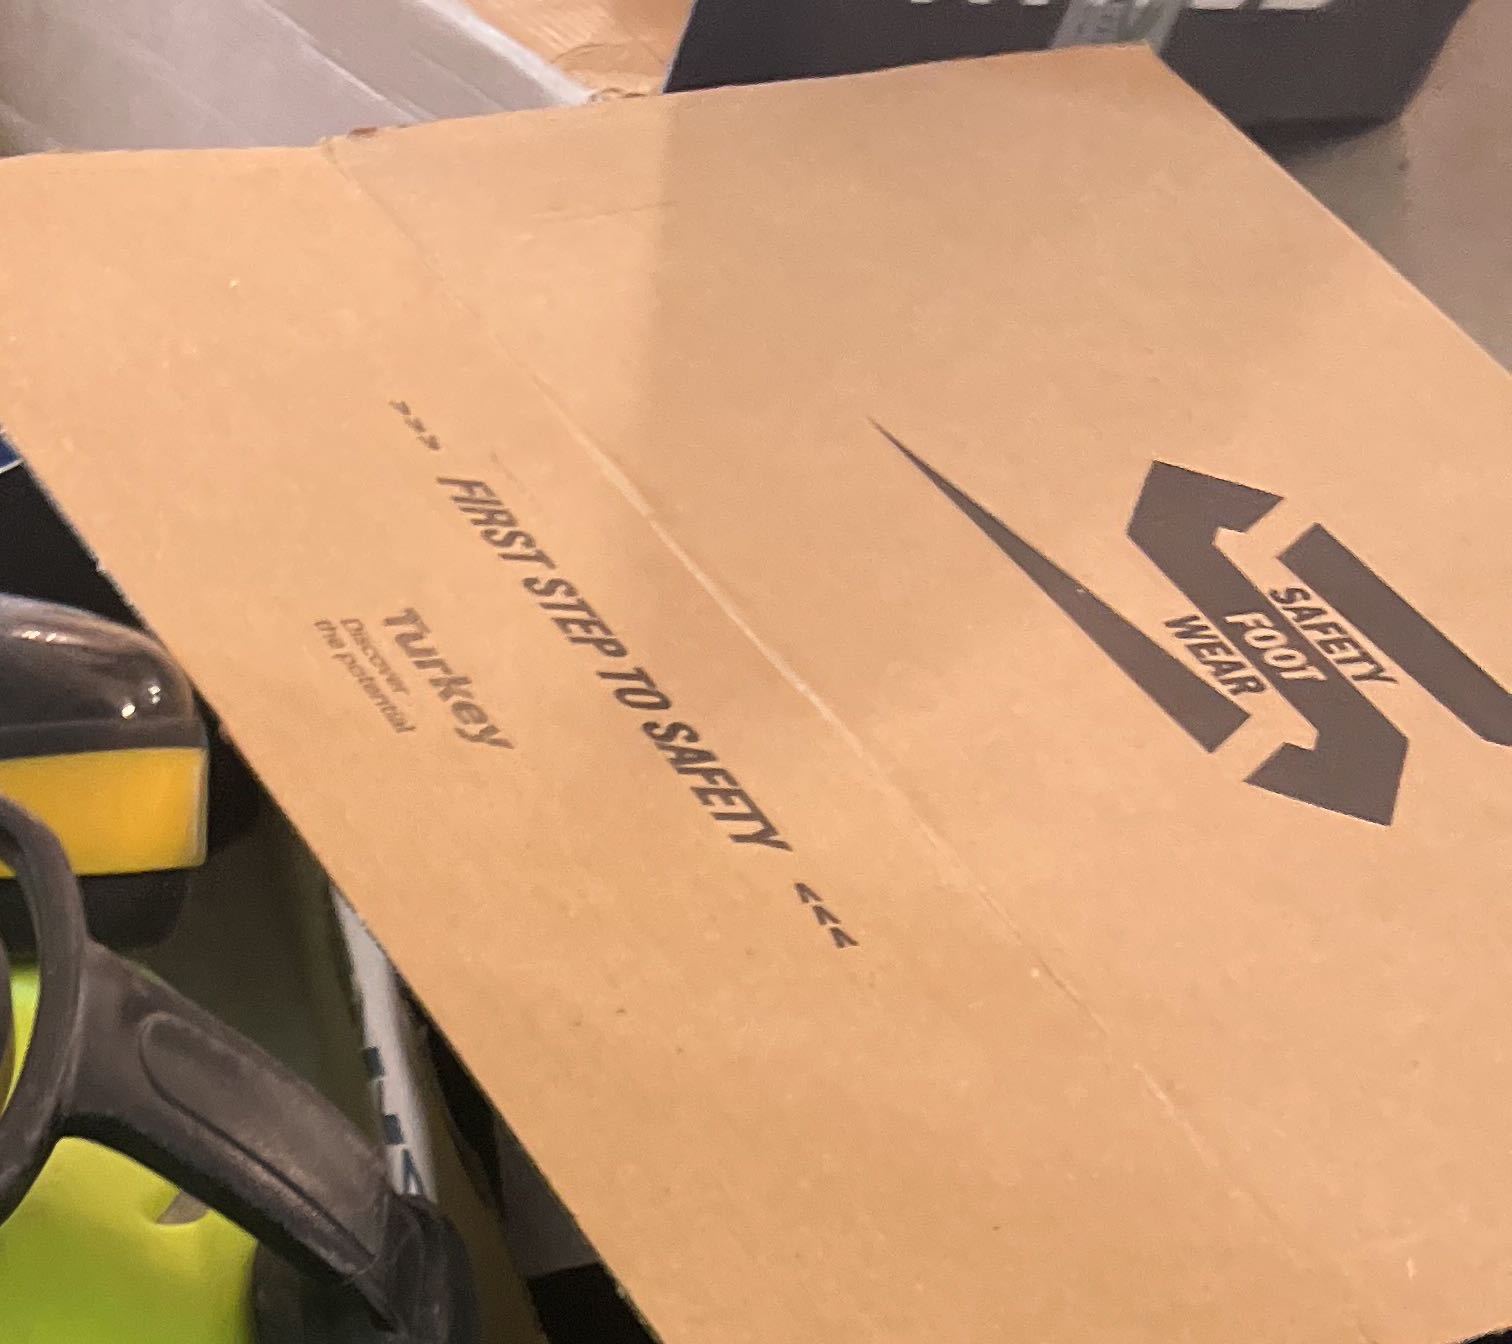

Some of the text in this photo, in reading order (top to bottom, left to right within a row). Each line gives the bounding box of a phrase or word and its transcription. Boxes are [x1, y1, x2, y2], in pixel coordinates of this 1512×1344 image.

[314, 618, 416, 734] the potential
[340, 618, 410, 695] Discover
[382, 607, 515, 750] Turkey
[436, 476, 792, 852] FIRST STEP TO SAFETY
[1162, 614, 1268, 697] WEAR
[1223, 611, 1328, 683] FOOT
[1269, 587, 1399, 687] SAFETY
